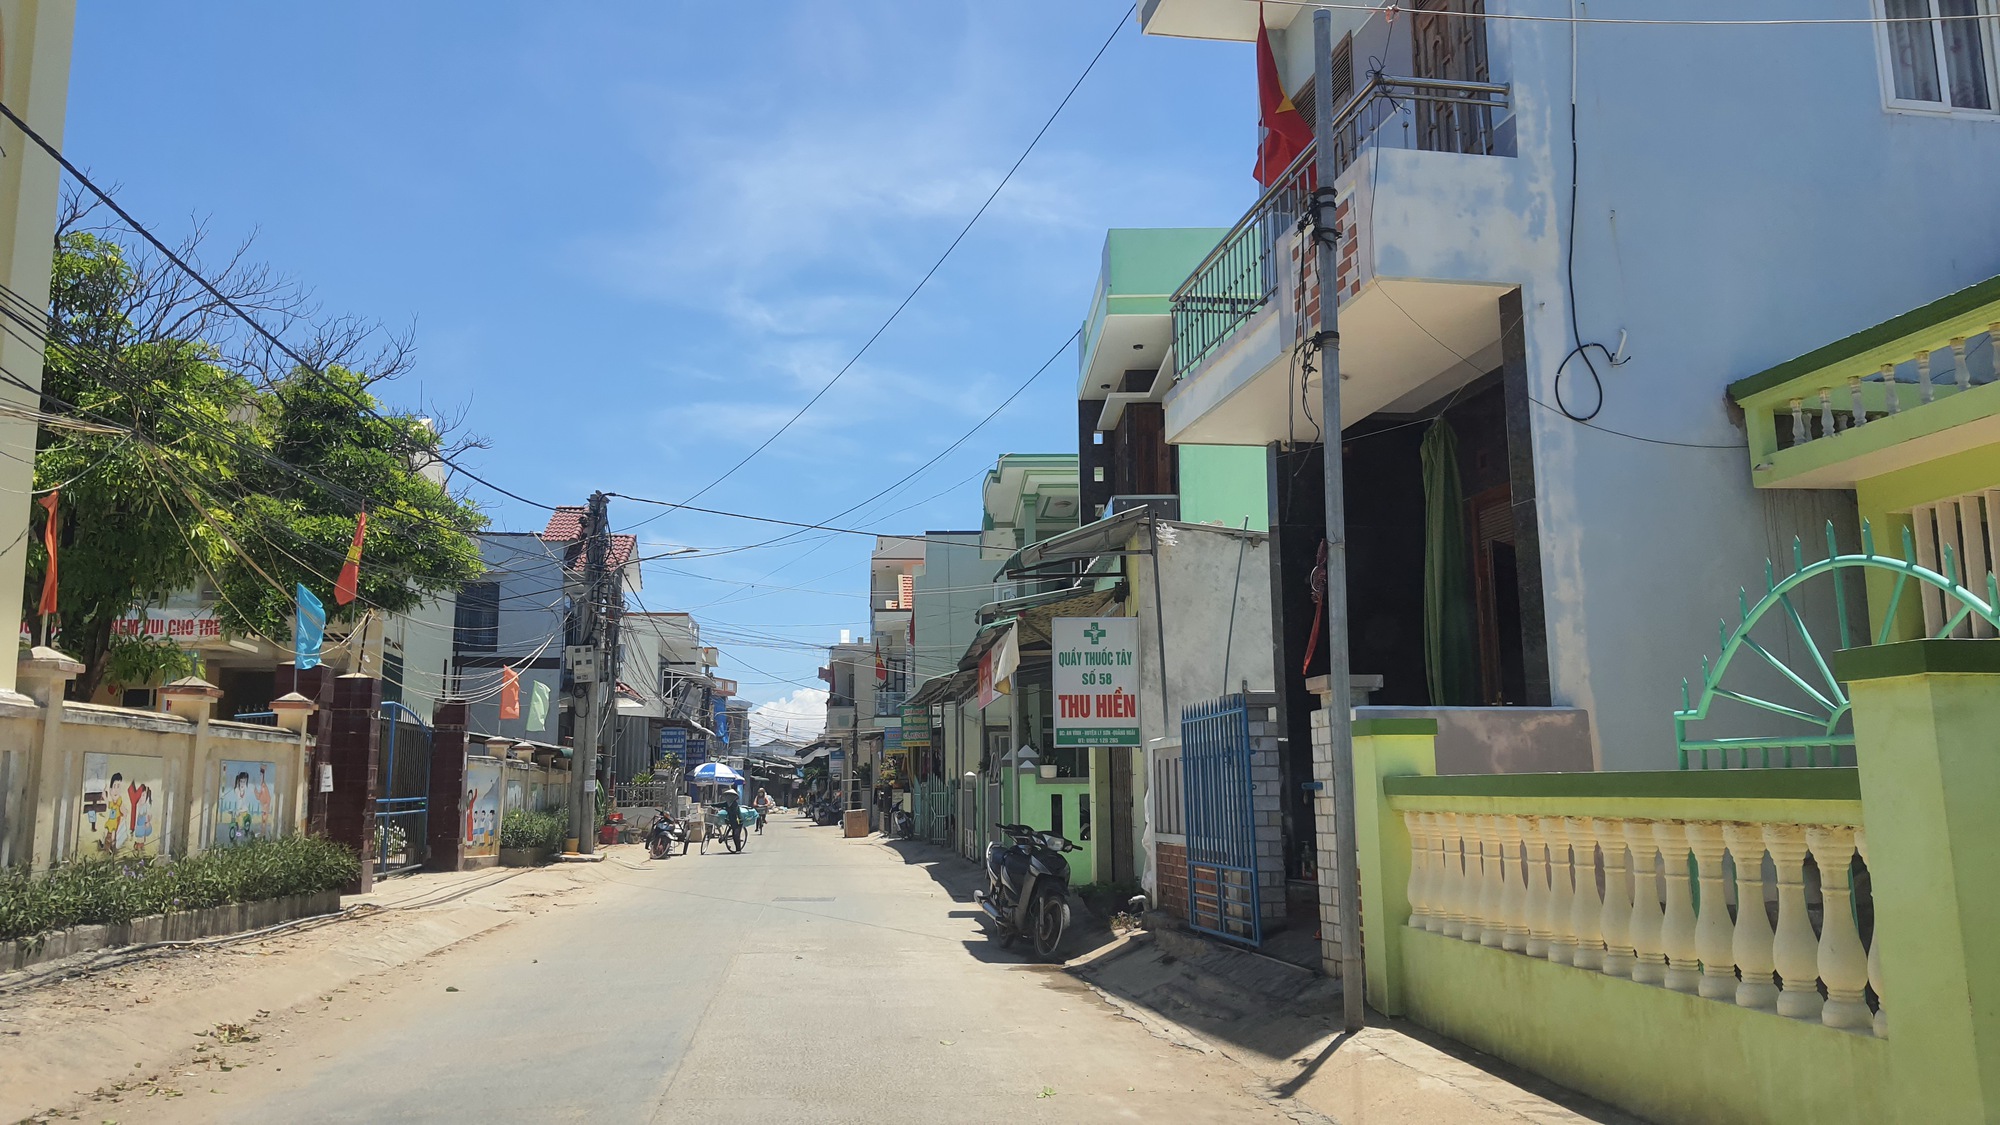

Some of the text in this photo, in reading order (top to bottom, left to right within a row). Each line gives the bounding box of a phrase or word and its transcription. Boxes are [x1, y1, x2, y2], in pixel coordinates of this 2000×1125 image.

[144, 619, 164, 634] VUI
[168, 619, 194, 636] CHO
[1084, 646, 1113, 666] THUỐC
[1115, 648, 1132, 666] TÂY
[1082, 669, 1112, 685] SỐ 58
[1058, 686, 1136, 718] THU HIỀN
